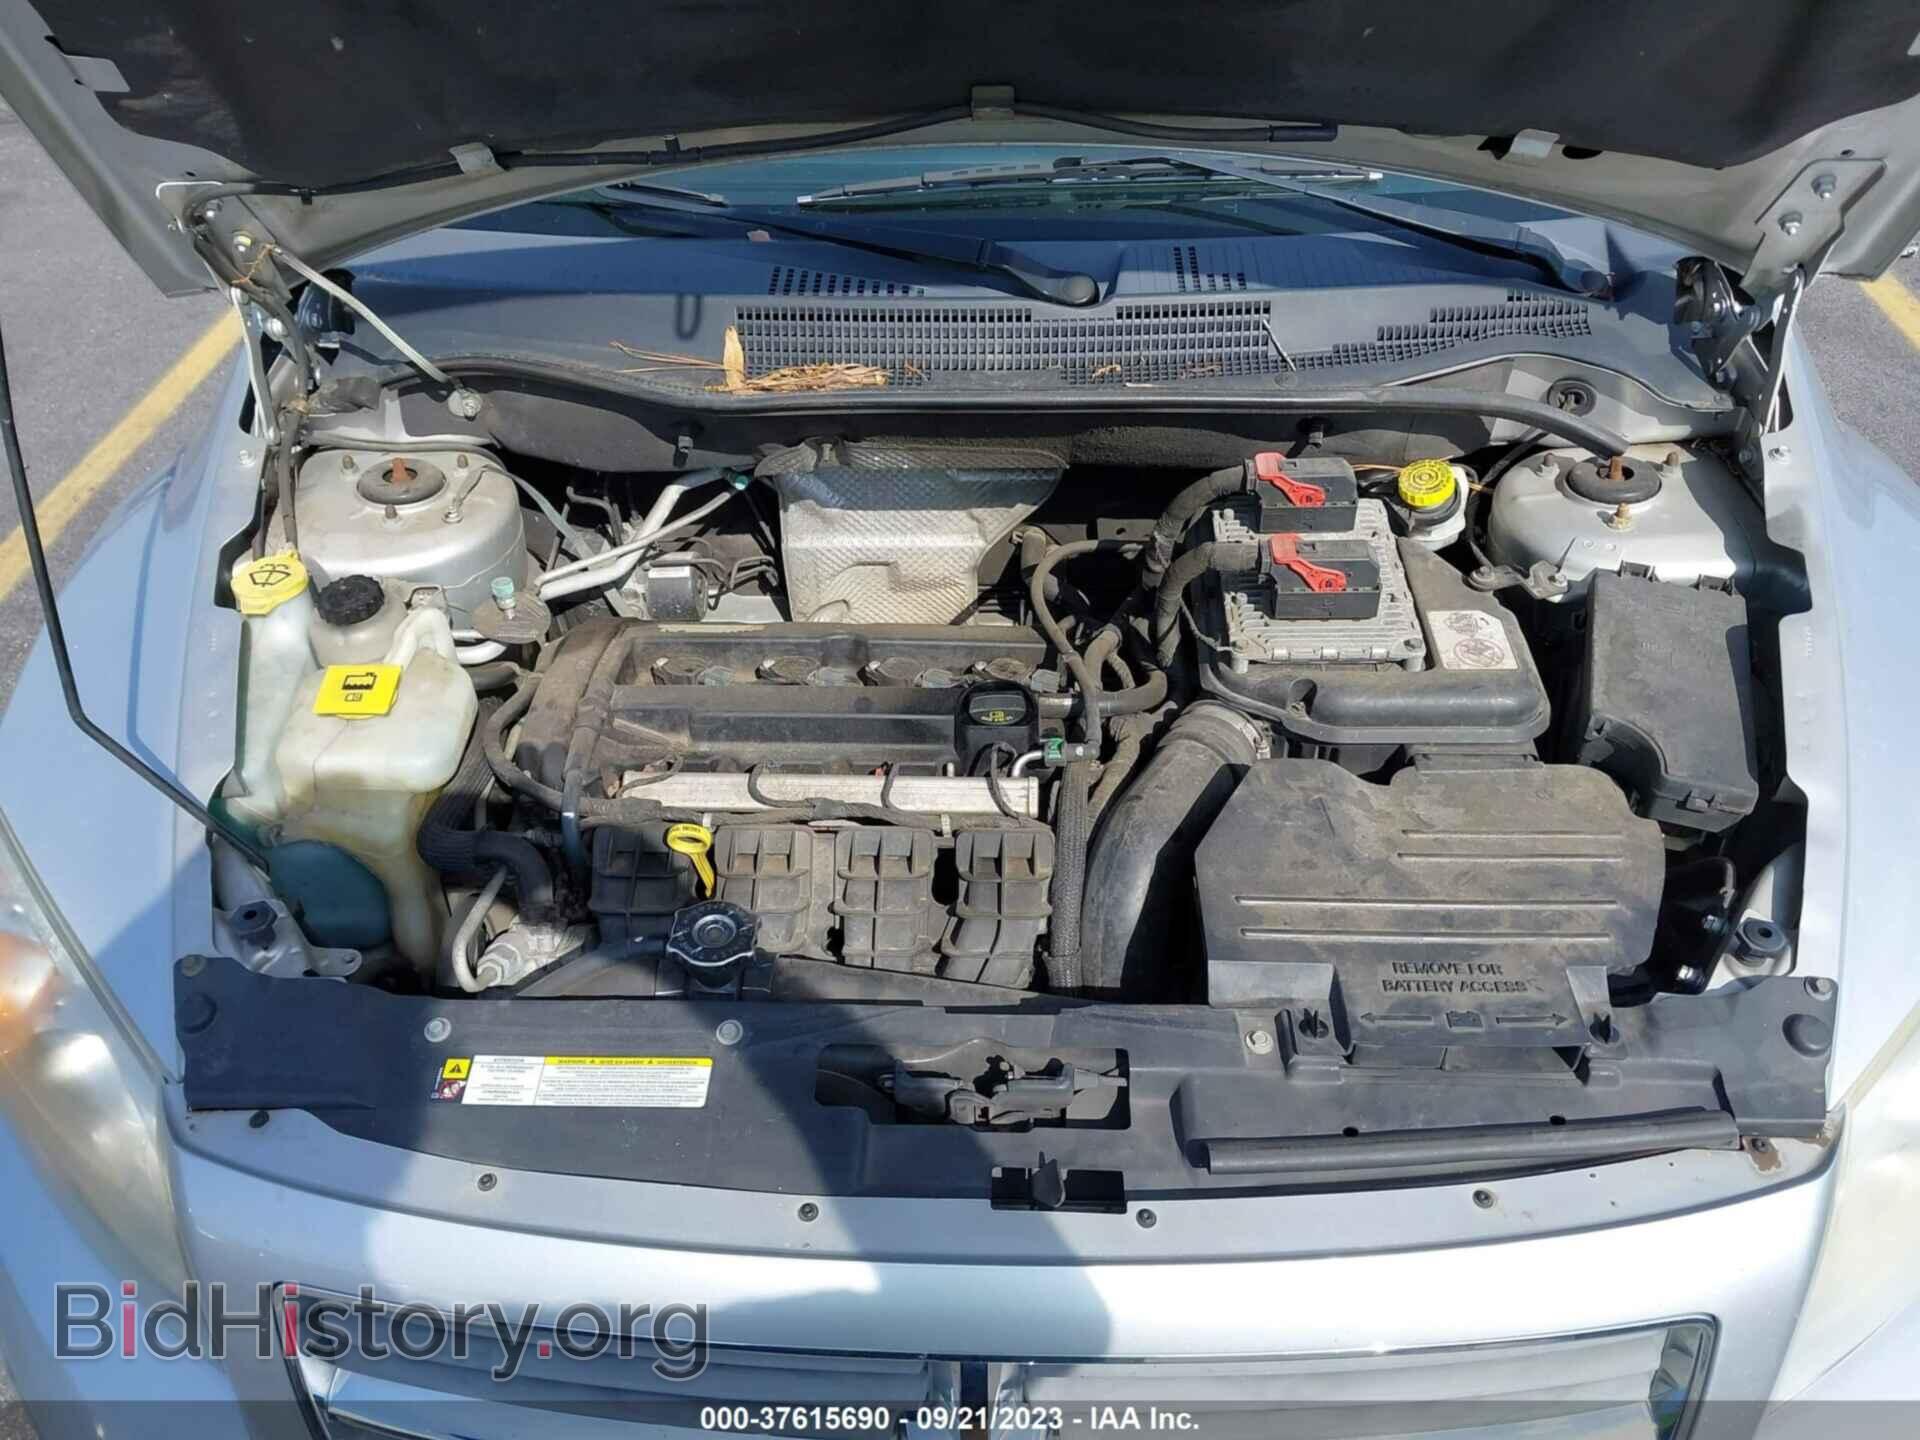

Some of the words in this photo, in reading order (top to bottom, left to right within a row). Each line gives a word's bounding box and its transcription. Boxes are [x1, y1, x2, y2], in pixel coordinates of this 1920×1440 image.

[1391, 961, 1463, 975] REMOVE
[1468, 962, 1504, 976] FOR
[1381, 979, 1454, 993] BATTERY
[1459, 980, 1529, 993] ACCESS
